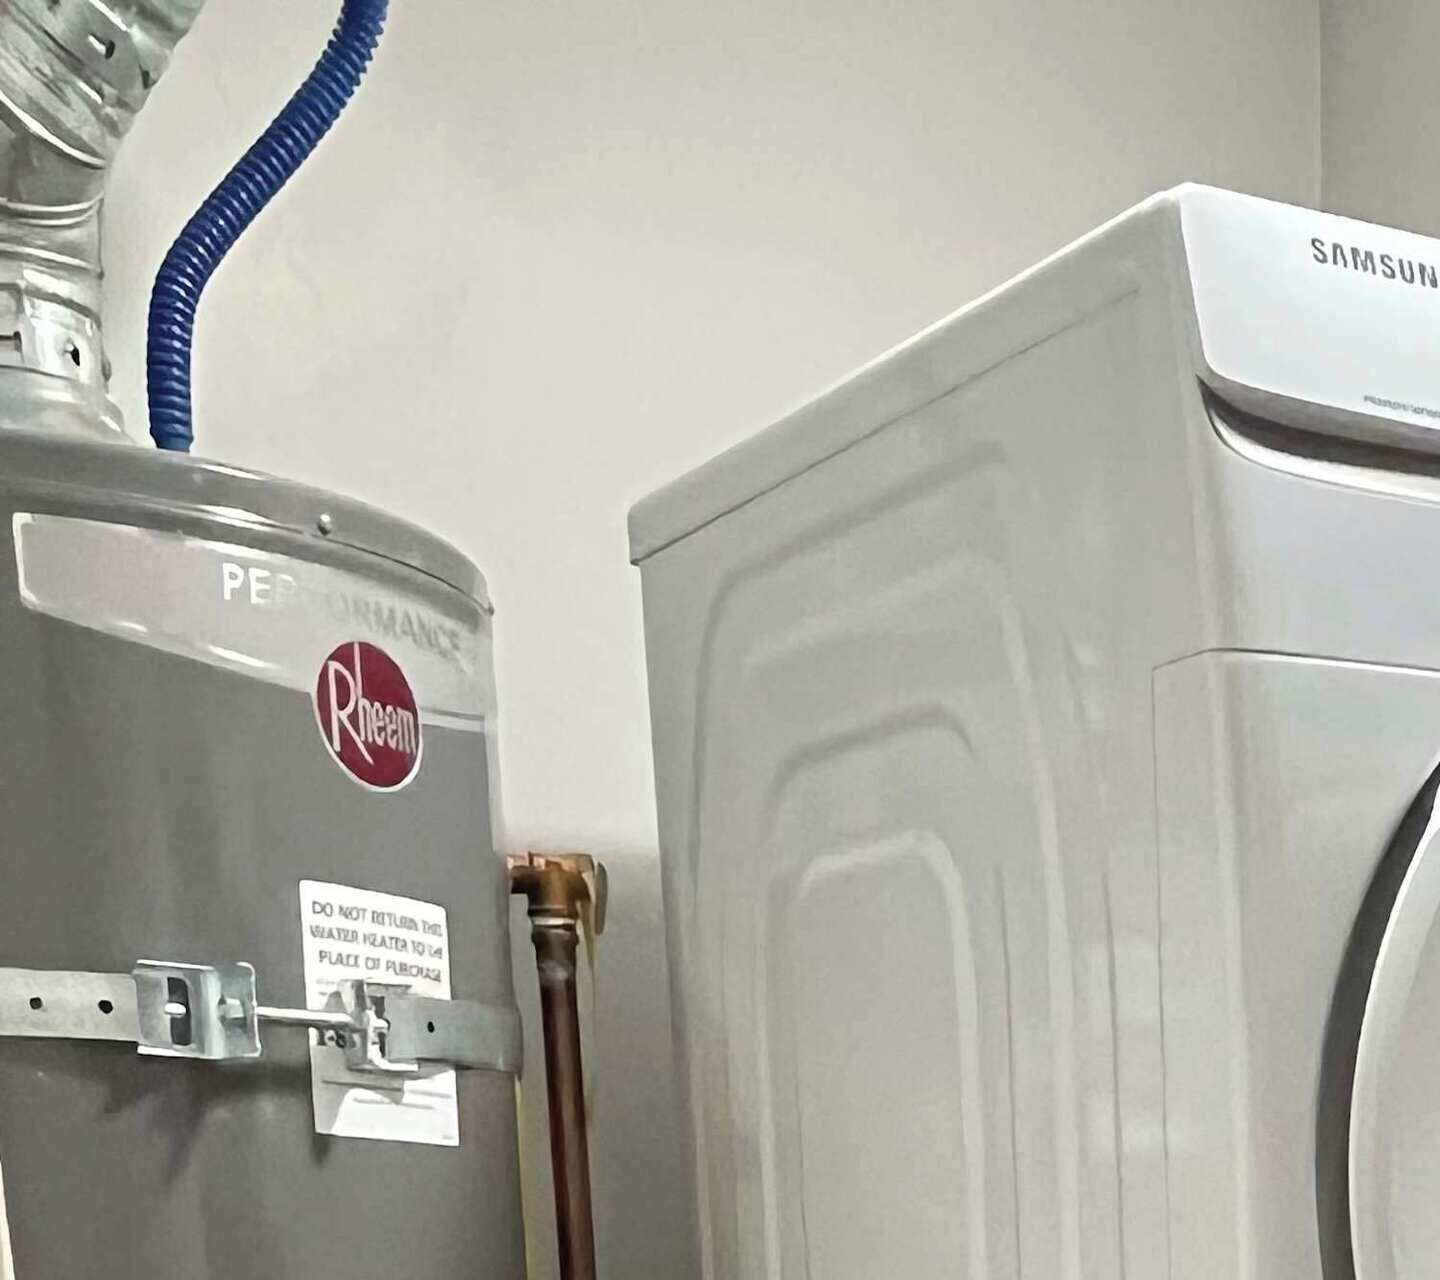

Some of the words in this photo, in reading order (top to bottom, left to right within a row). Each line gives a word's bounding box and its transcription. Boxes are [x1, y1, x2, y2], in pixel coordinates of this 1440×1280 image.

[221, 562, 462, 653] PERORMANCE
[326, 640, 417, 766] Rheem
[311, 900, 333, 918] DO
[337, 903, 367, 923] NOT
